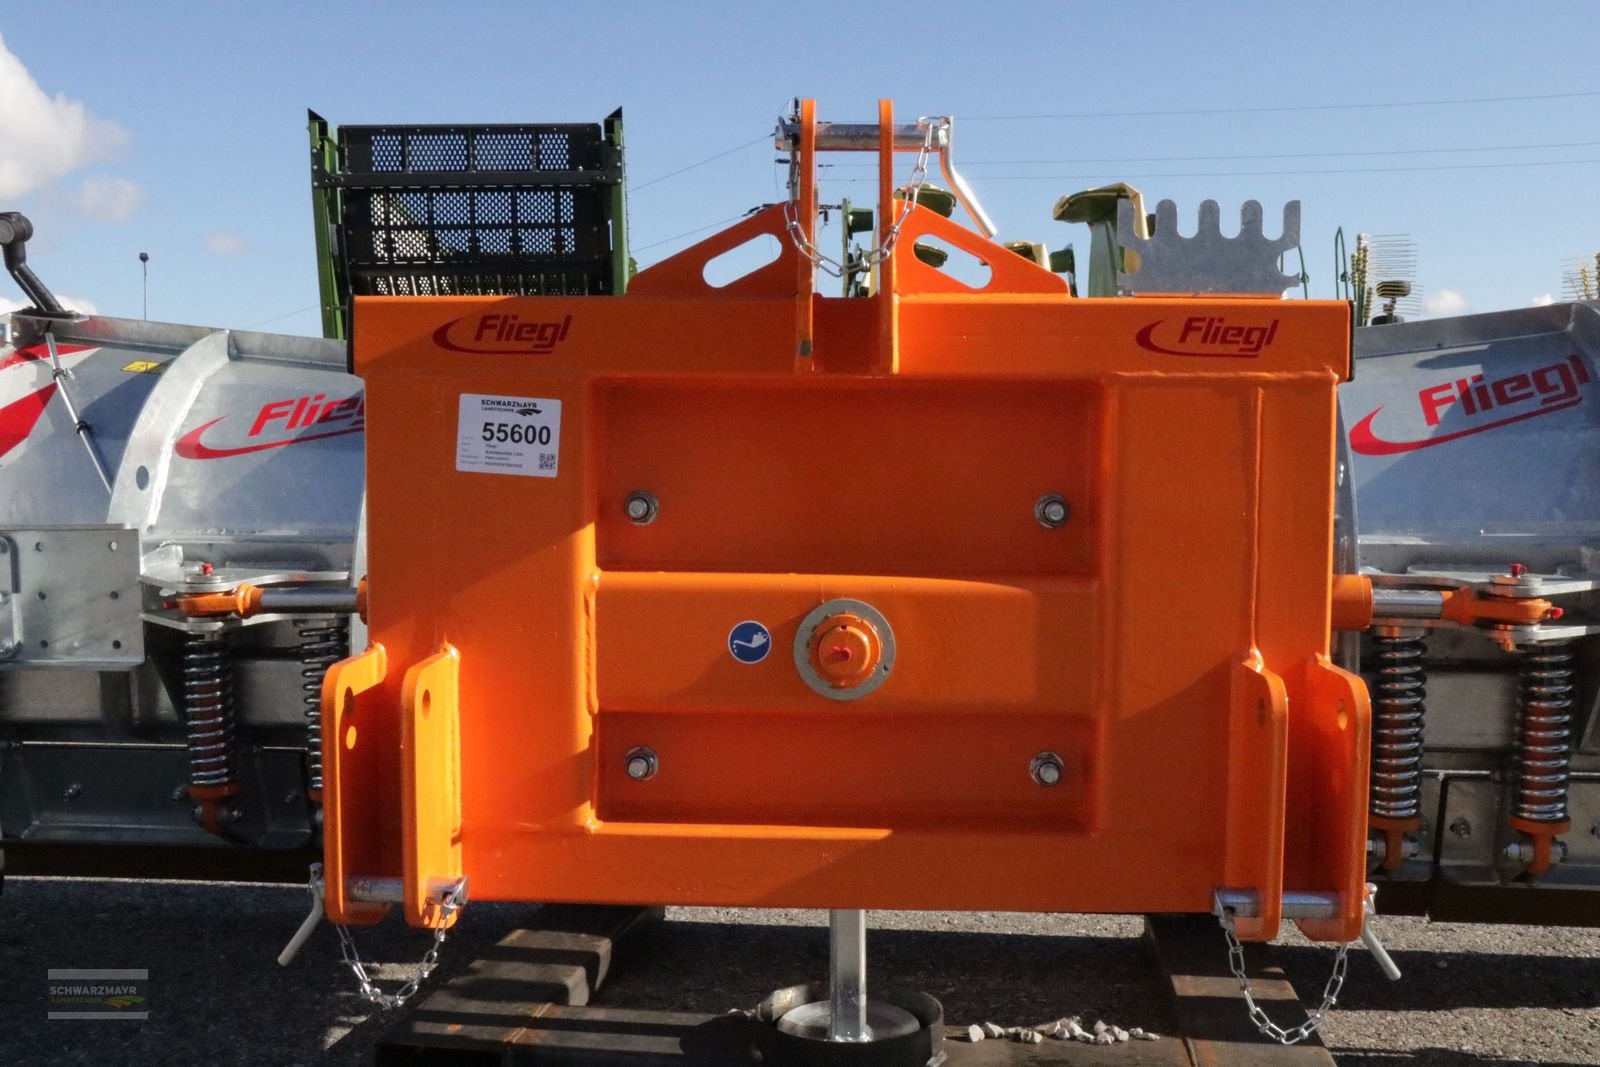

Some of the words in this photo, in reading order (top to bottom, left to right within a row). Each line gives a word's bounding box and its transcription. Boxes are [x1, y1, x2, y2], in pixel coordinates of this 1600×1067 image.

[475, 315, 571, 348] Fliegl
[1178, 317, 1279, 352] Fliegl
[481, 399, 537, 408] SCHWARZMAYR
[1418, 354, 1590, 427] Fliegl
[482, 422, 551, 445] 55600
